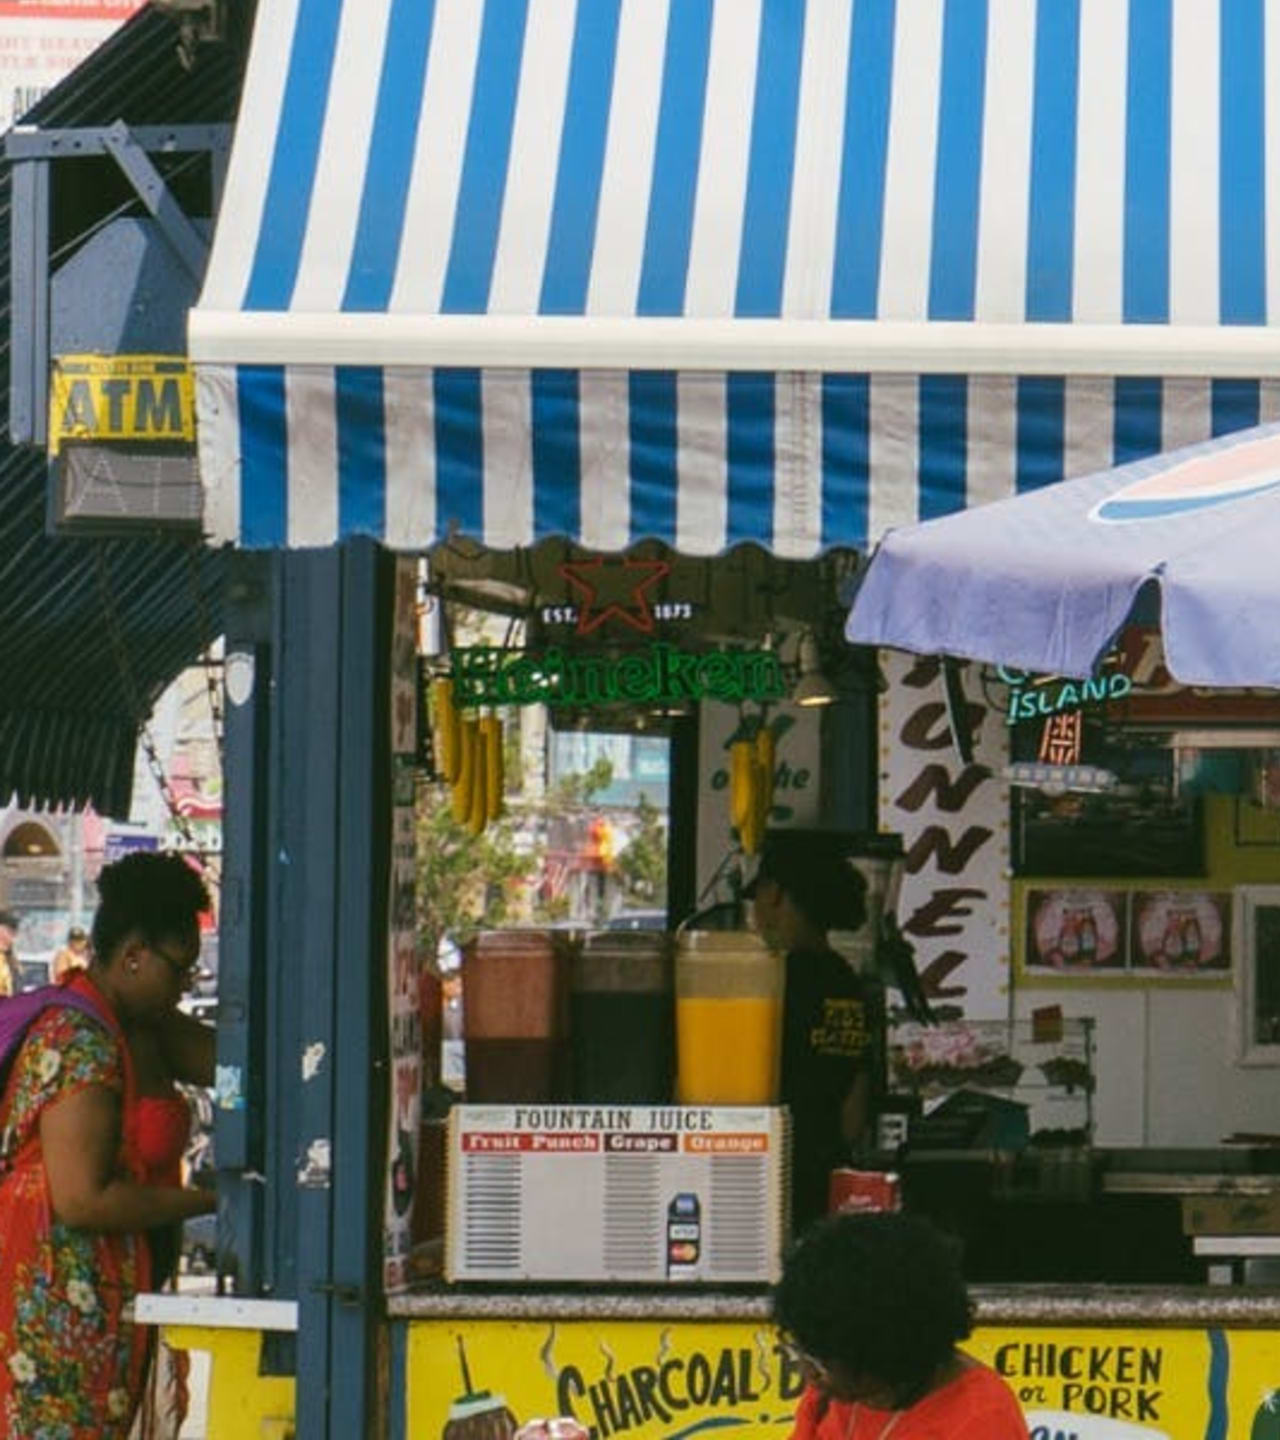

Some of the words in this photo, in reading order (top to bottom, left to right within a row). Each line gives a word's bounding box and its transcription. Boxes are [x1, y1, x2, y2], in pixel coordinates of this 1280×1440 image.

[62, 379, 182, 432] ATM
[1007, 672, 1132, 724] ISLAND
[513, 1108, 631, 1131] FOUNTAIN
[648, 1108, 714, 1131] JUICE
[467, 1133, 520, 1150] Fruit
[531, 1134, 597, 1151] Punch
[609, 1134, 673, 1152] Grape
[689, 1136, 766, 1153] Orange
[994, 1342, 1163, 1385] CHICKEN
[557, 1348, 759, 1440] CHARCOAL
[1019, 1386, 1047, 1403] or
[1062, 1382, 1163, 1422] PORK
